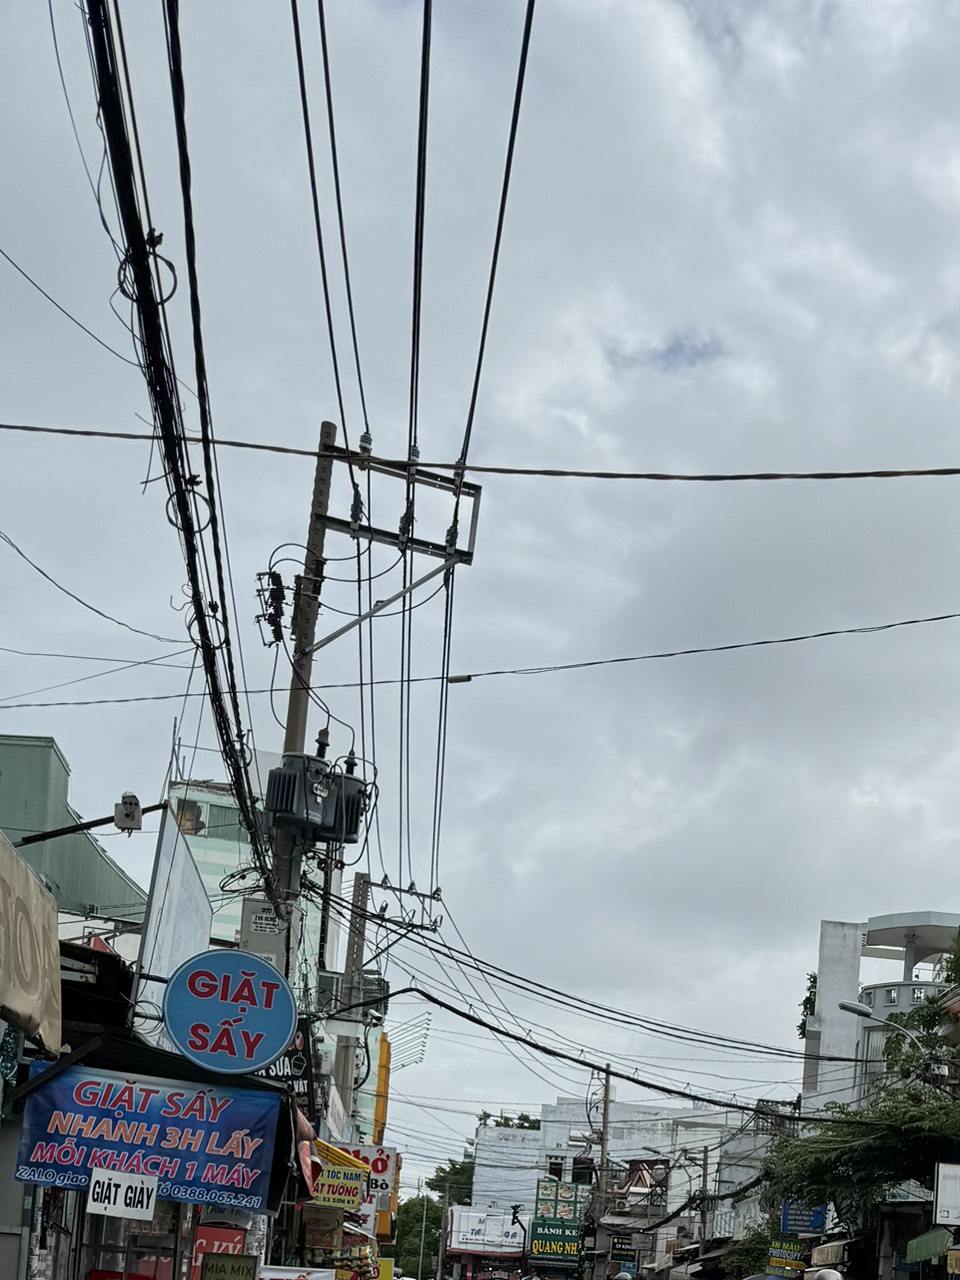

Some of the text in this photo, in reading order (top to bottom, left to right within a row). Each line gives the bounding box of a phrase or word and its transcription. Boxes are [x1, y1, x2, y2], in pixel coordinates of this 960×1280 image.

[187, 969, 281, 1013] GIẶT
[187, 1017, 265, 1060] SẤY
[73, 1079, 233, 1123] GIẶT SẤY
[47, 1110, 263, 1160] NHANH 3H LẤY
[30, 1138, 262, 1189] MỖI KHÁCH 1 MÁY
[343, 1171, 361, 1182] NAM
[16, 1166, 262, 1209] ZALO giao 0388.065.241
[92, 1177, 155, 1211] GIẶT GIÀY
[313, 1180, 325, 1194] ÁT
[371, 1178, 390, 1191] Bò
[532, 1240, 563, 1255] QUANG
[564, 1242, 579, 1255] NH
[537, 1226, 579, 1237] BÁNH KE
[205, 1261, 253, 1277] MÍA MIX
